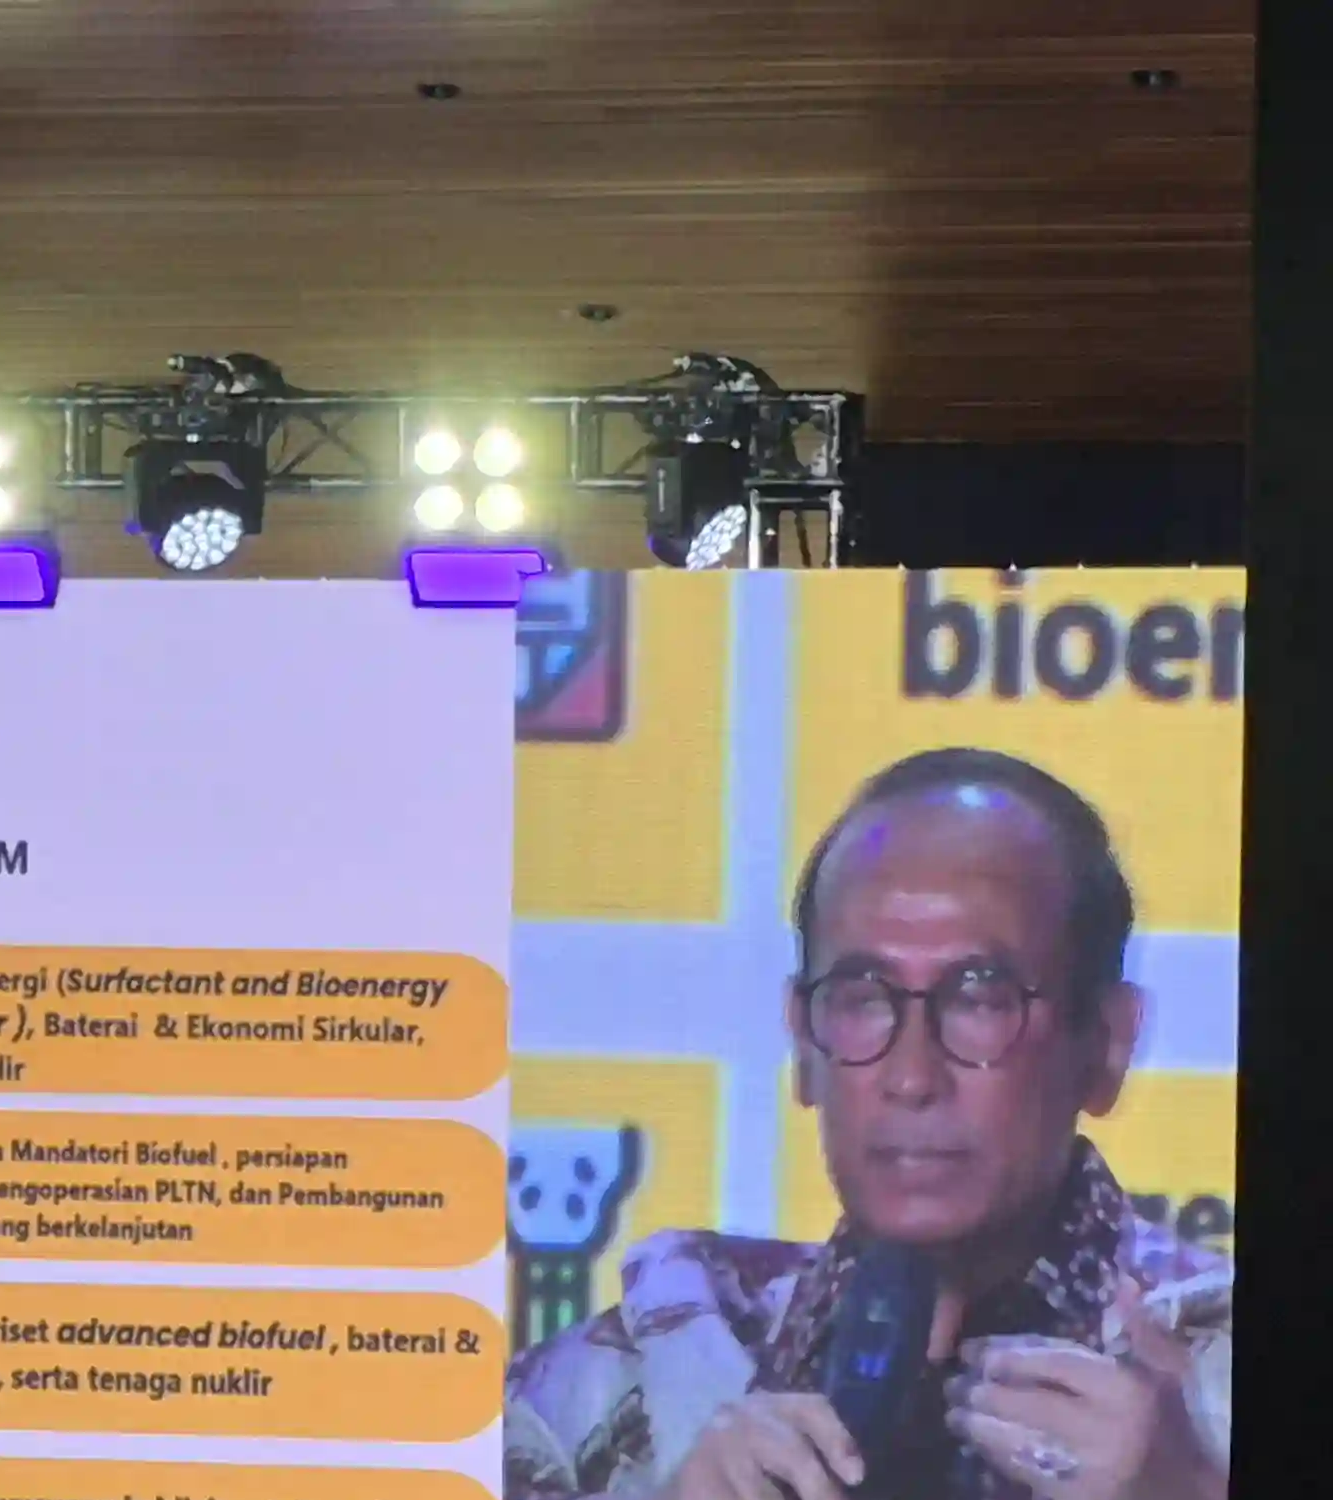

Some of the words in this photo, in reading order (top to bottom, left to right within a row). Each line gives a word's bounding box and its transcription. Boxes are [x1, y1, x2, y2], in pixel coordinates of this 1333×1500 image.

[57, 966, 224, 997] (Surfactant
[232, 971, 289, 997] and
[297, 971, 448, 1007] Bioenergy
[45, 1012, 137, 1038] Baterai
[154, 1014, 177, 1038] &
[187, 1015, 303, 1042] Ekonomi
[313, 1016, 424, 1045] Sirkular,
[11, 1139, 128, 1165] Mandatori
[236, 1144, 347, 1175] persiapan
[155, 1179, 221, 1206] PLTN,
[230, 1181, 271, 1204] dan
[279, 1182, 443, 1213] Pembangunan
[36, 1213, 193, 1244] berkelanjutan
[58, 1318, 212, 1350] advanced
[348, 1326, 445, 1353] baterai
[455, 1328, 480, 1355] &
[11, 1365, 78, 1390] serta
[88, 1367, 183, 1400] tenaga
[191, 1368, 272, 1397] nuklir
